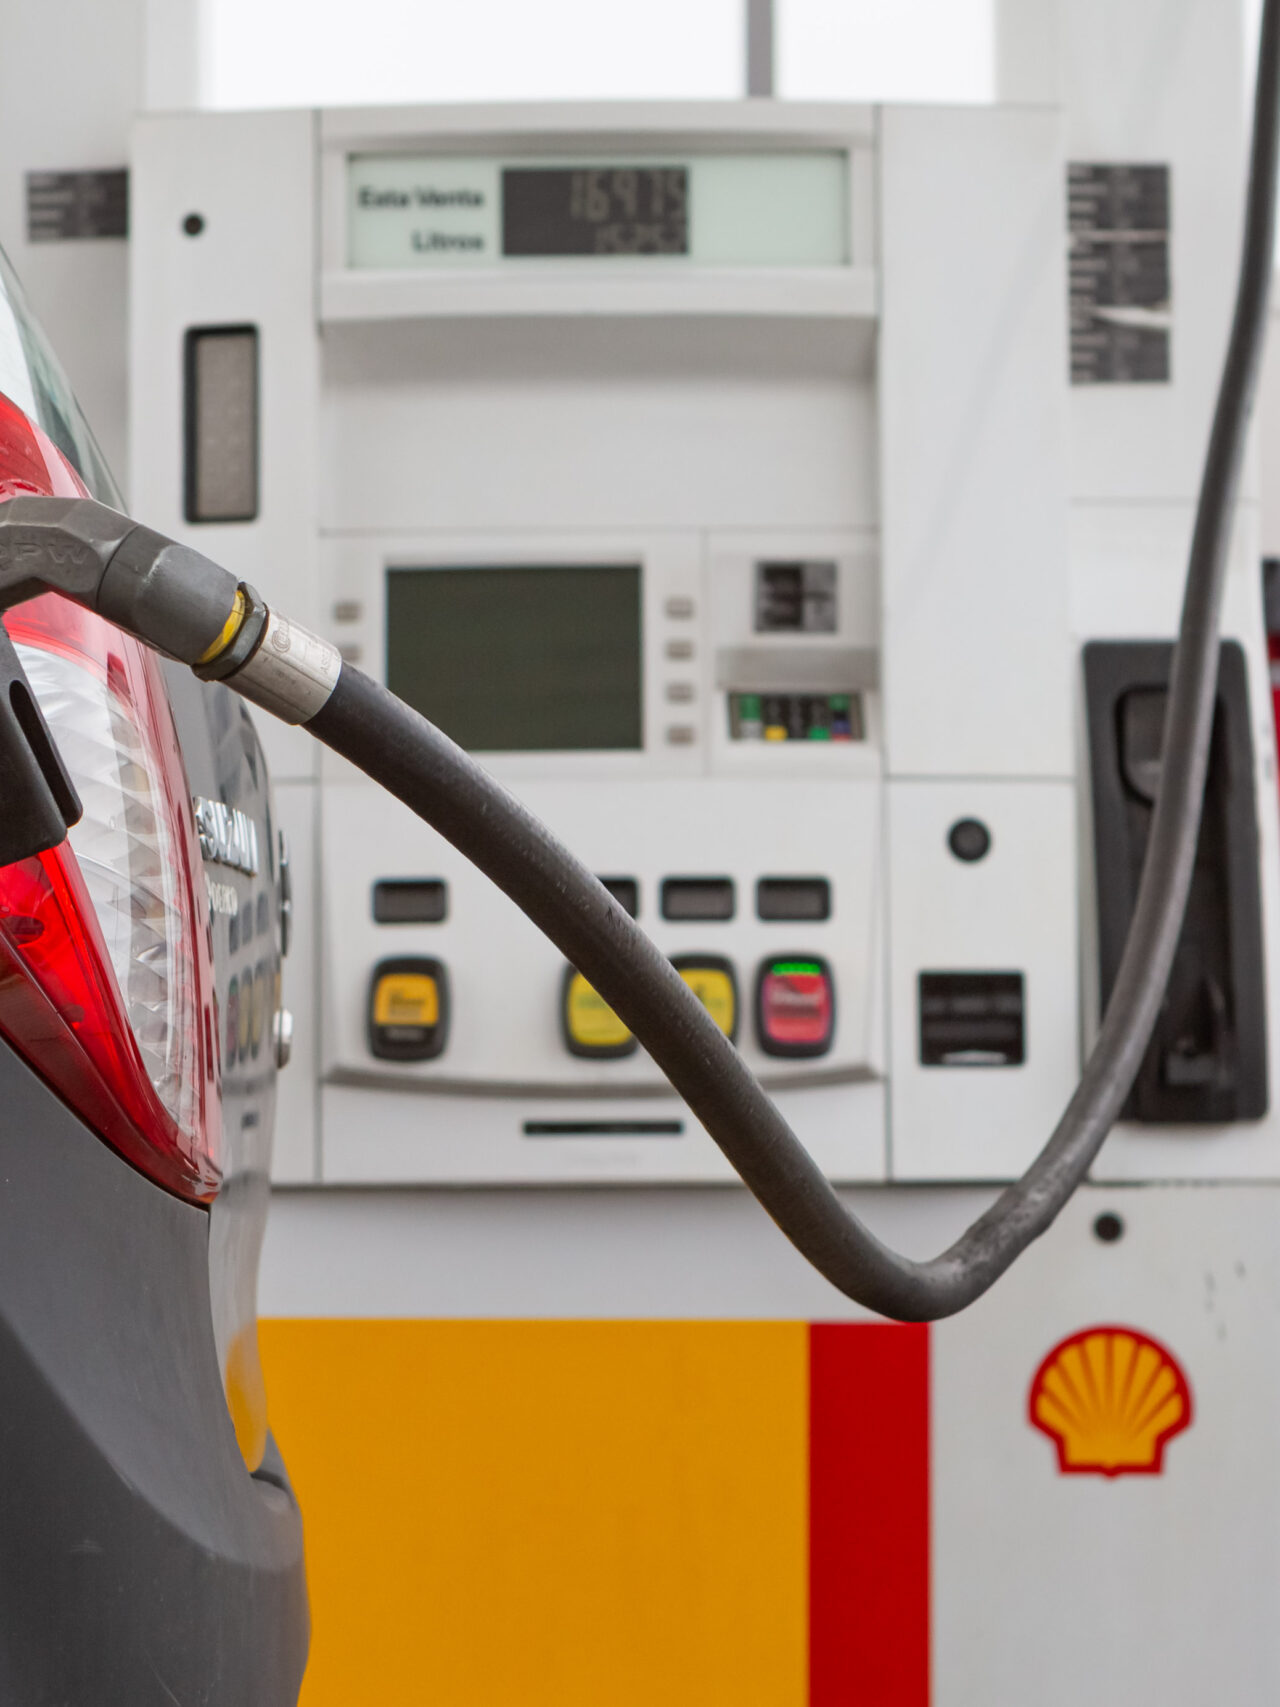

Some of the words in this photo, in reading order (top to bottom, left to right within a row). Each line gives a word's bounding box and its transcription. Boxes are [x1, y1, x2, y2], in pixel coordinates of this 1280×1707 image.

[357, 185, 409, 209] Esta
[414, 185, 485, 209] Venta
[411, 230, 485, 252] Litros
